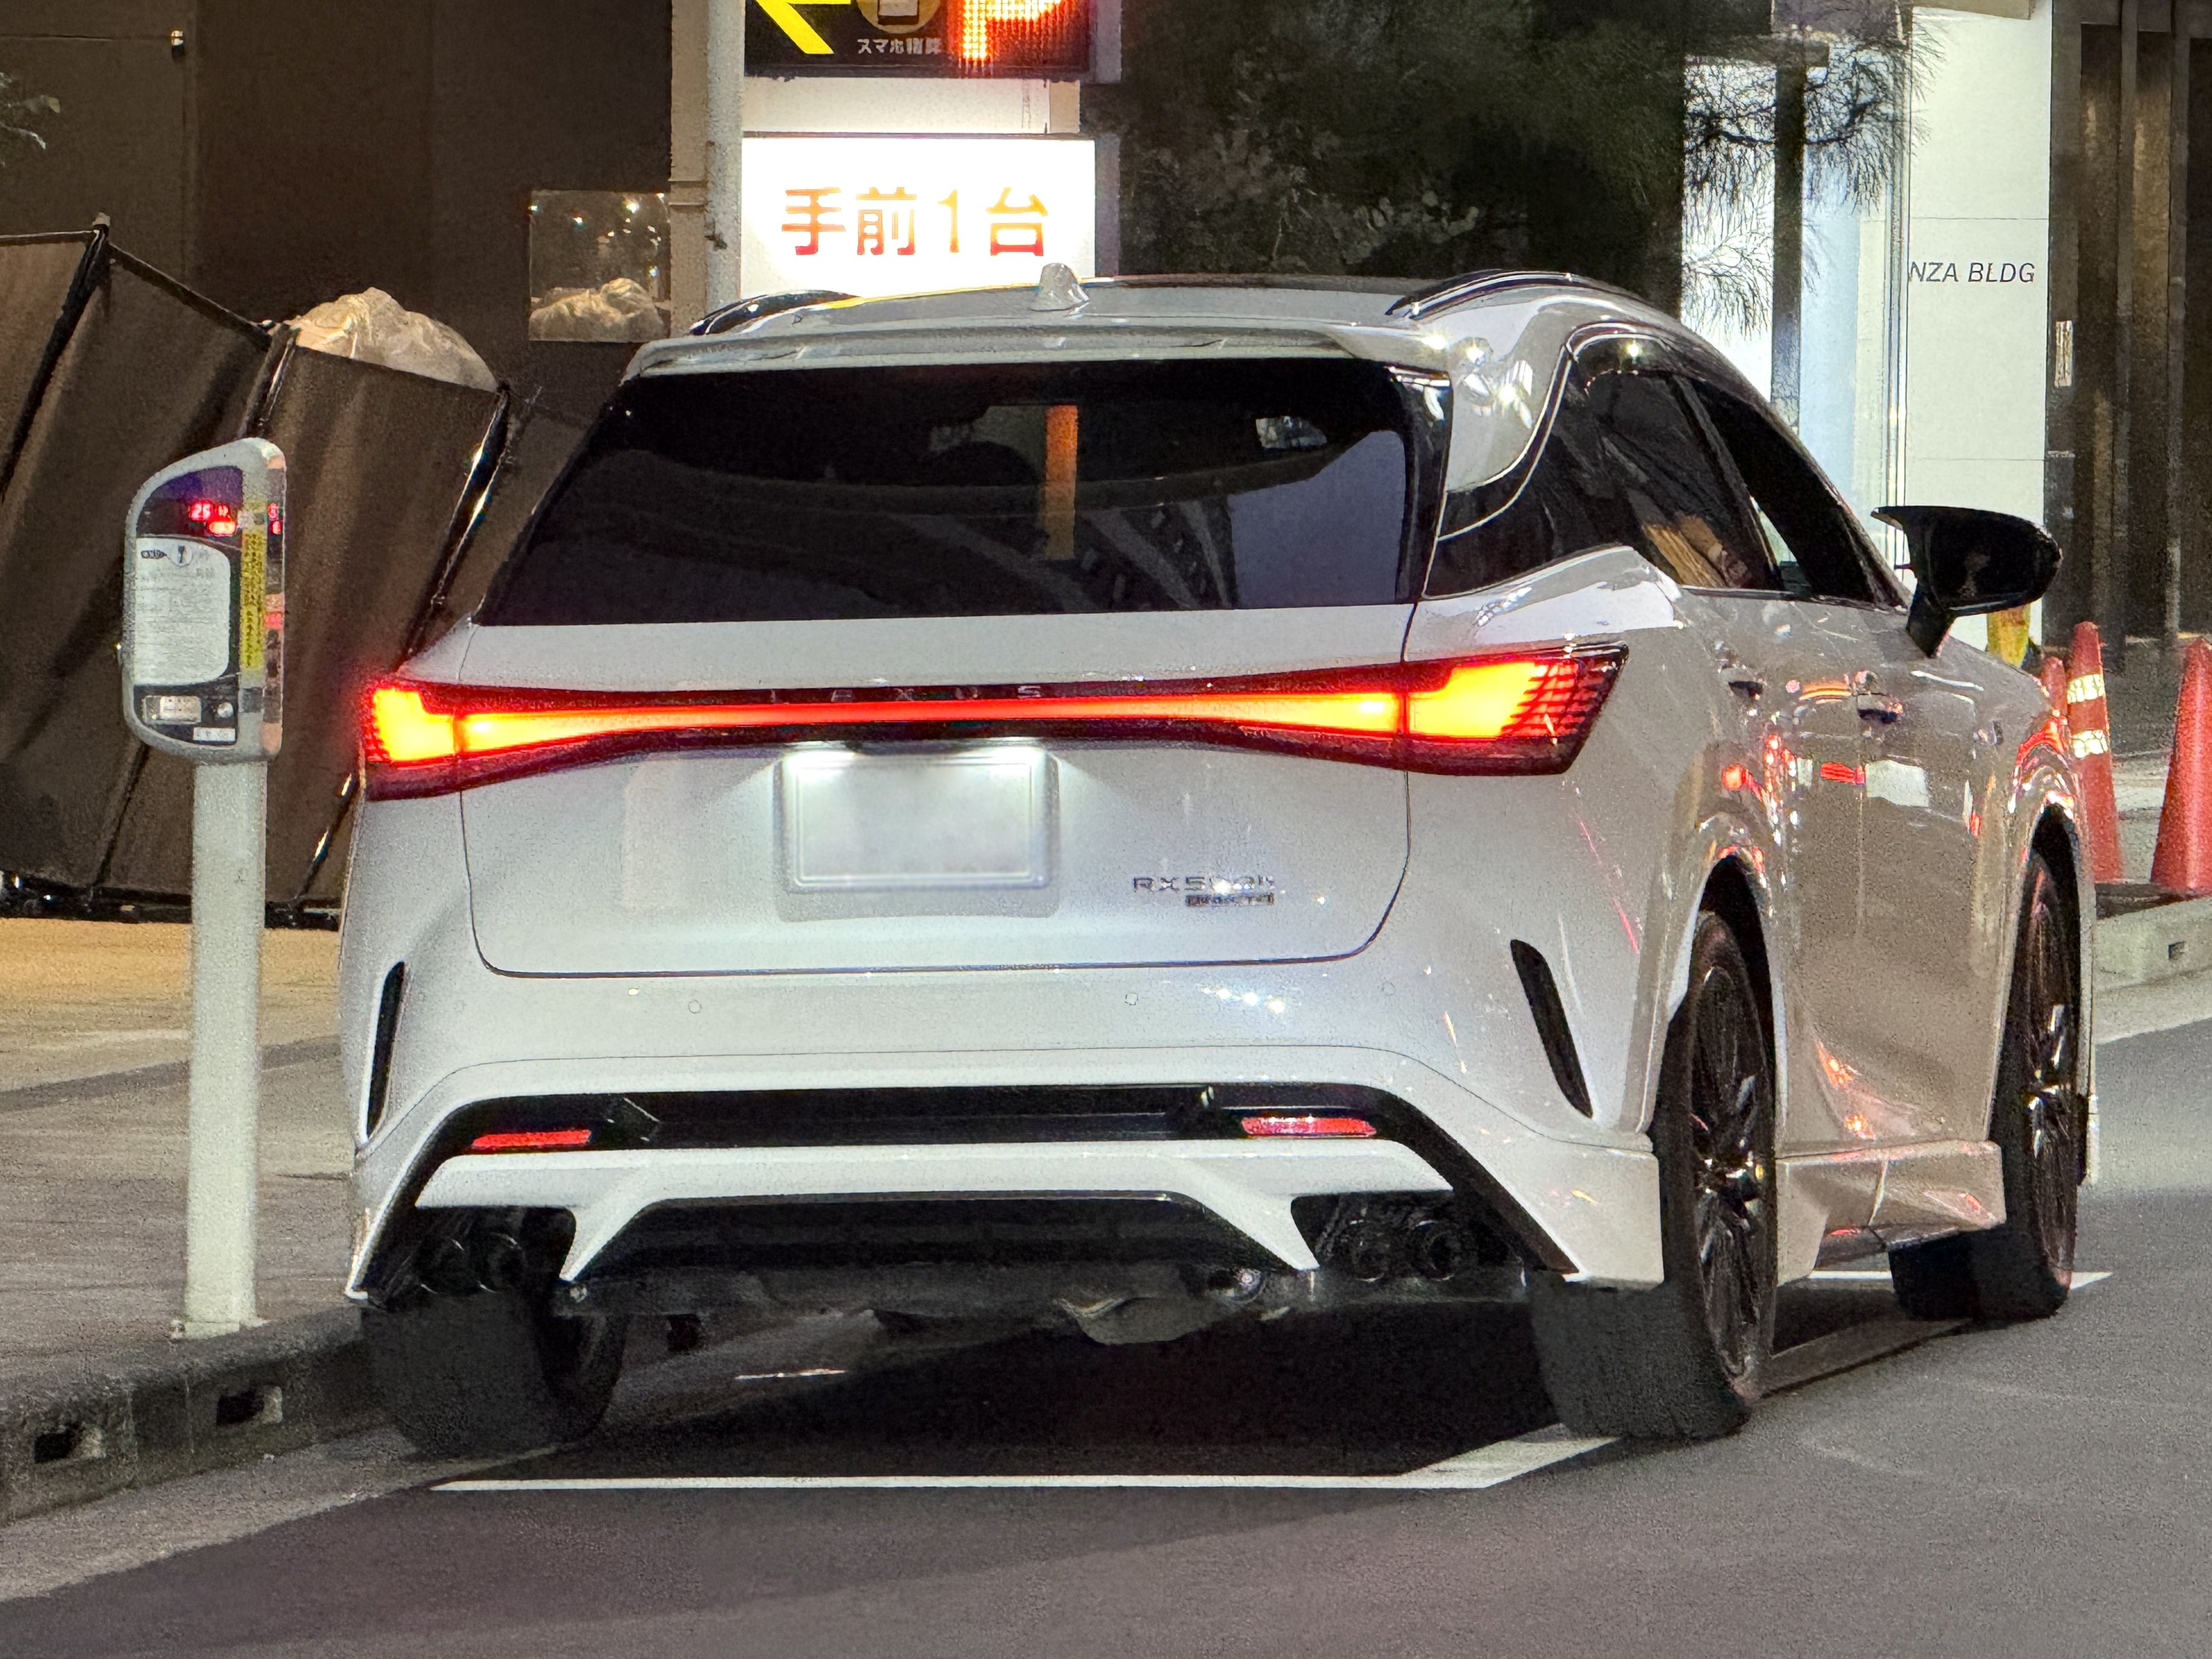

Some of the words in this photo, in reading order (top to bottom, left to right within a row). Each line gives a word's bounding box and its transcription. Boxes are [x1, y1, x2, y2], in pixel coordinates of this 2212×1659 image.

[781, 186, 1048, 256] 手前1台
[1908, 261, 1959, 282] NZA
[1968, 262, 2035, 283] BLDG
